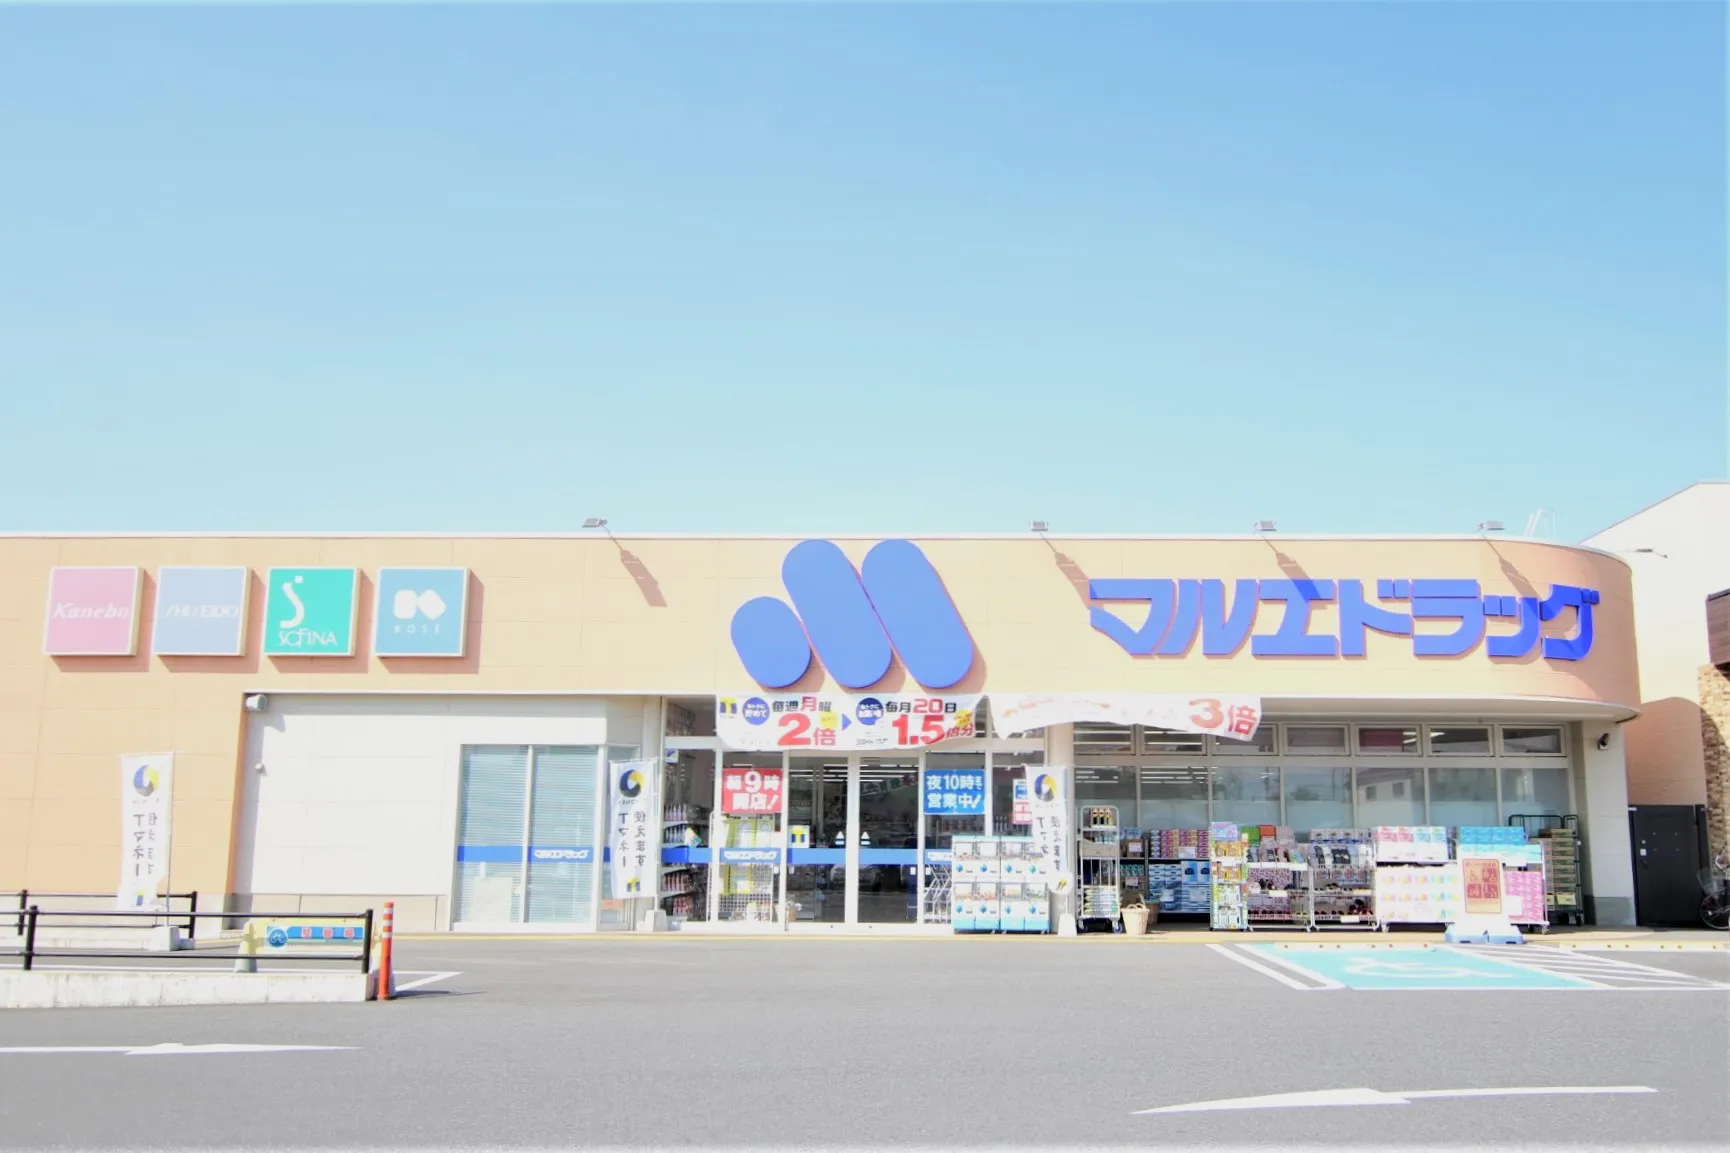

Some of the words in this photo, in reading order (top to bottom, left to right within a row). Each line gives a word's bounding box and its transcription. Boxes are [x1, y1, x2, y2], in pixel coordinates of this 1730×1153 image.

[52, 602, 130, 620] Kanebo
[1090, 579, 1600, 661] マルエドラッグ
[279, 629, 338, 647] SOFINA
[885, 698, 957, 713] 毎月20日
[1189, 698, 1258, 735] 3倍
[777, 713, 836, 746] 2倍
[927, 793, 981, 809] 営業中!
